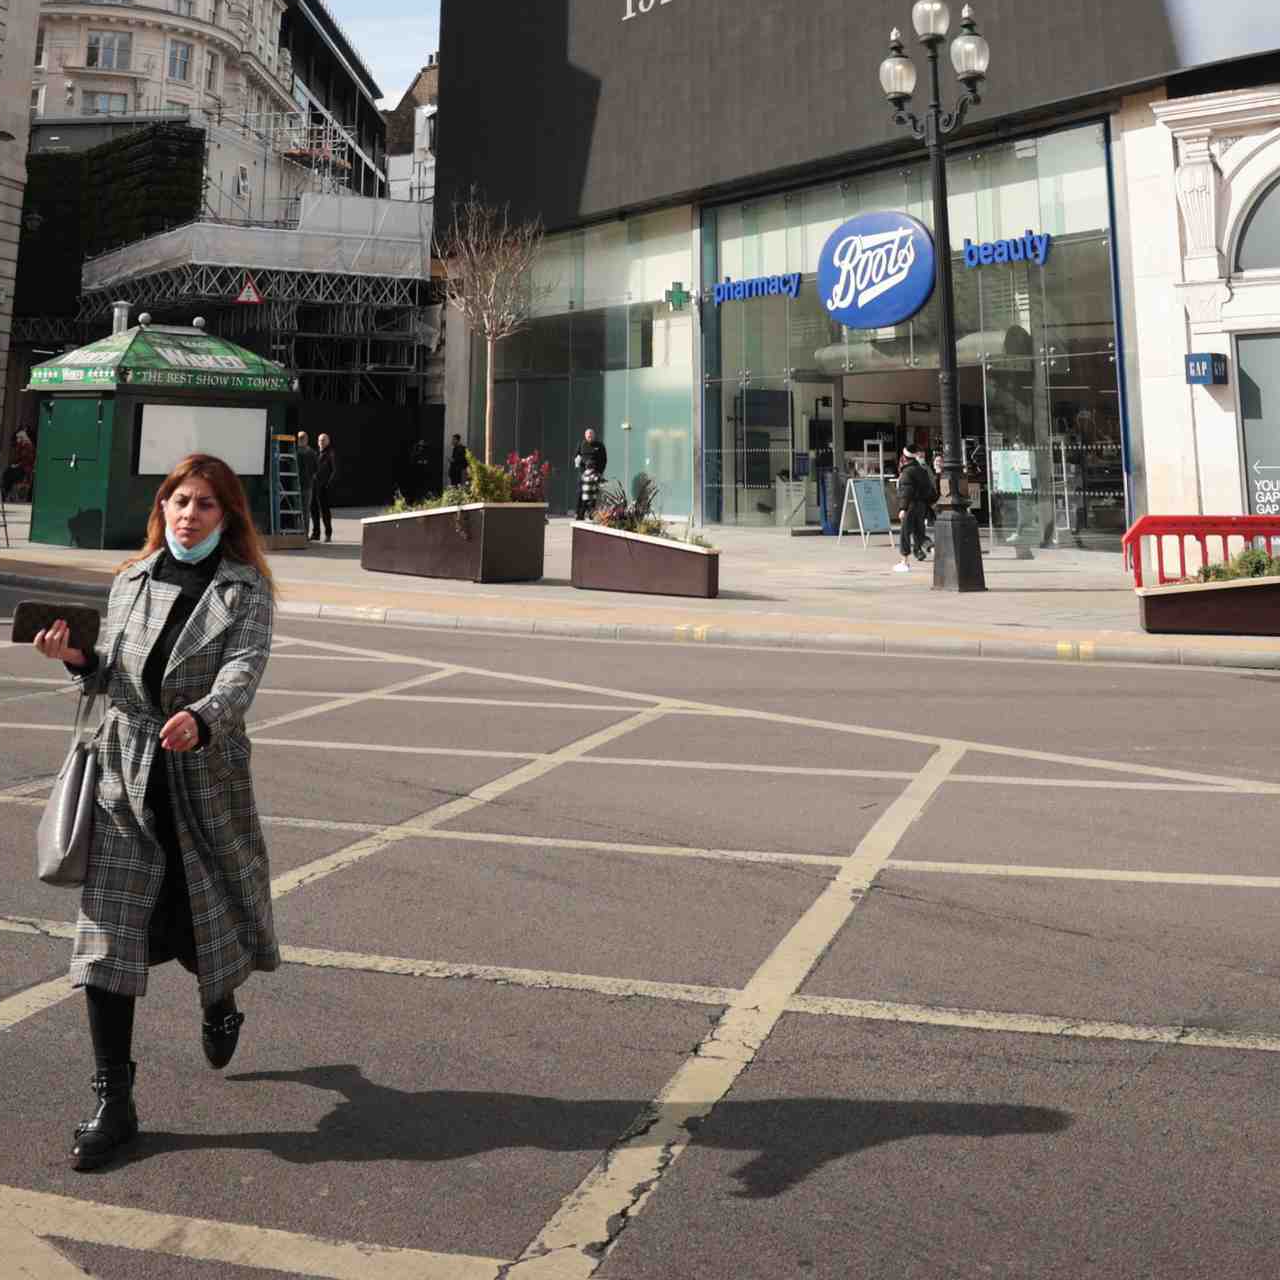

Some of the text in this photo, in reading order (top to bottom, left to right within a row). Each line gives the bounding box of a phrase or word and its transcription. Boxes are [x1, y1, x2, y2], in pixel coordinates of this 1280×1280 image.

[963, 226, 1051, 268] beauty
[827, 226, 915, 312] Boots
[712, 271, 802, 306] pharmacy
[1189, 360, 1208, 377] GAP
[167, 374, 193, 385] BEST
[196, 374, 231, 386] SHOW
[231, 375, 244, 386] IN
[1255, 492, 1280, 503] GAP
[1256, 504, 1280, 514] GAP
